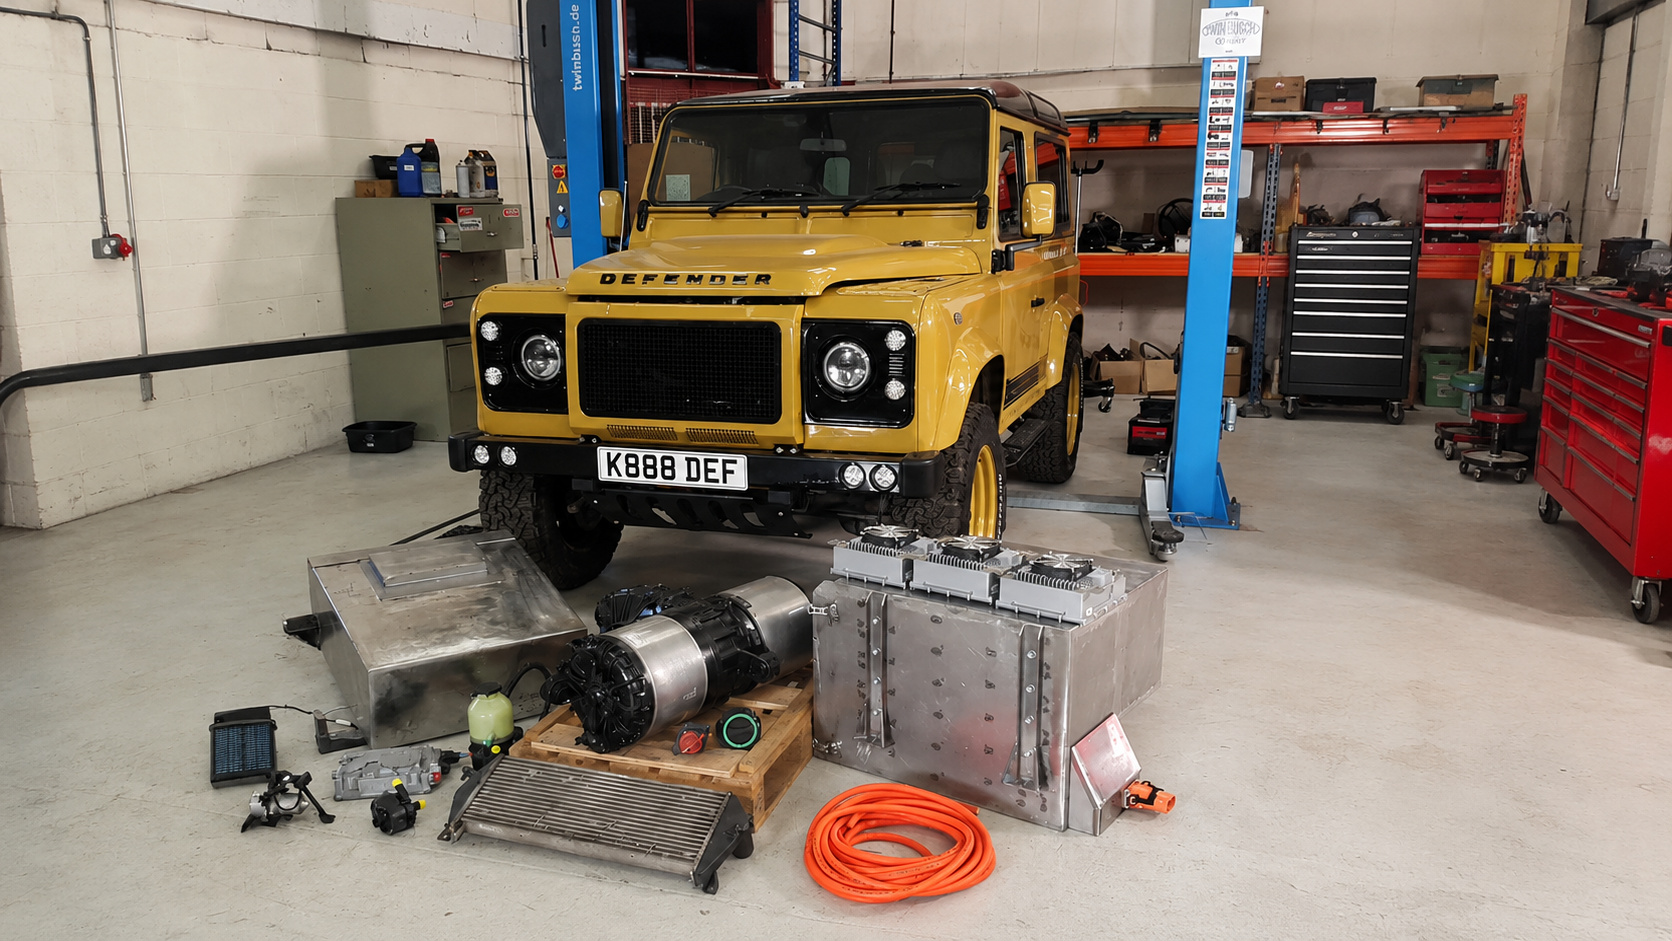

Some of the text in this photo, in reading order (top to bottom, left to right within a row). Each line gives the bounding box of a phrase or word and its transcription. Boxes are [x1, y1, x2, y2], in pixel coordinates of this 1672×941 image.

[599, 273, 772, 286] DEFENDER
[606, 451, 737, 484] K888 DEF
